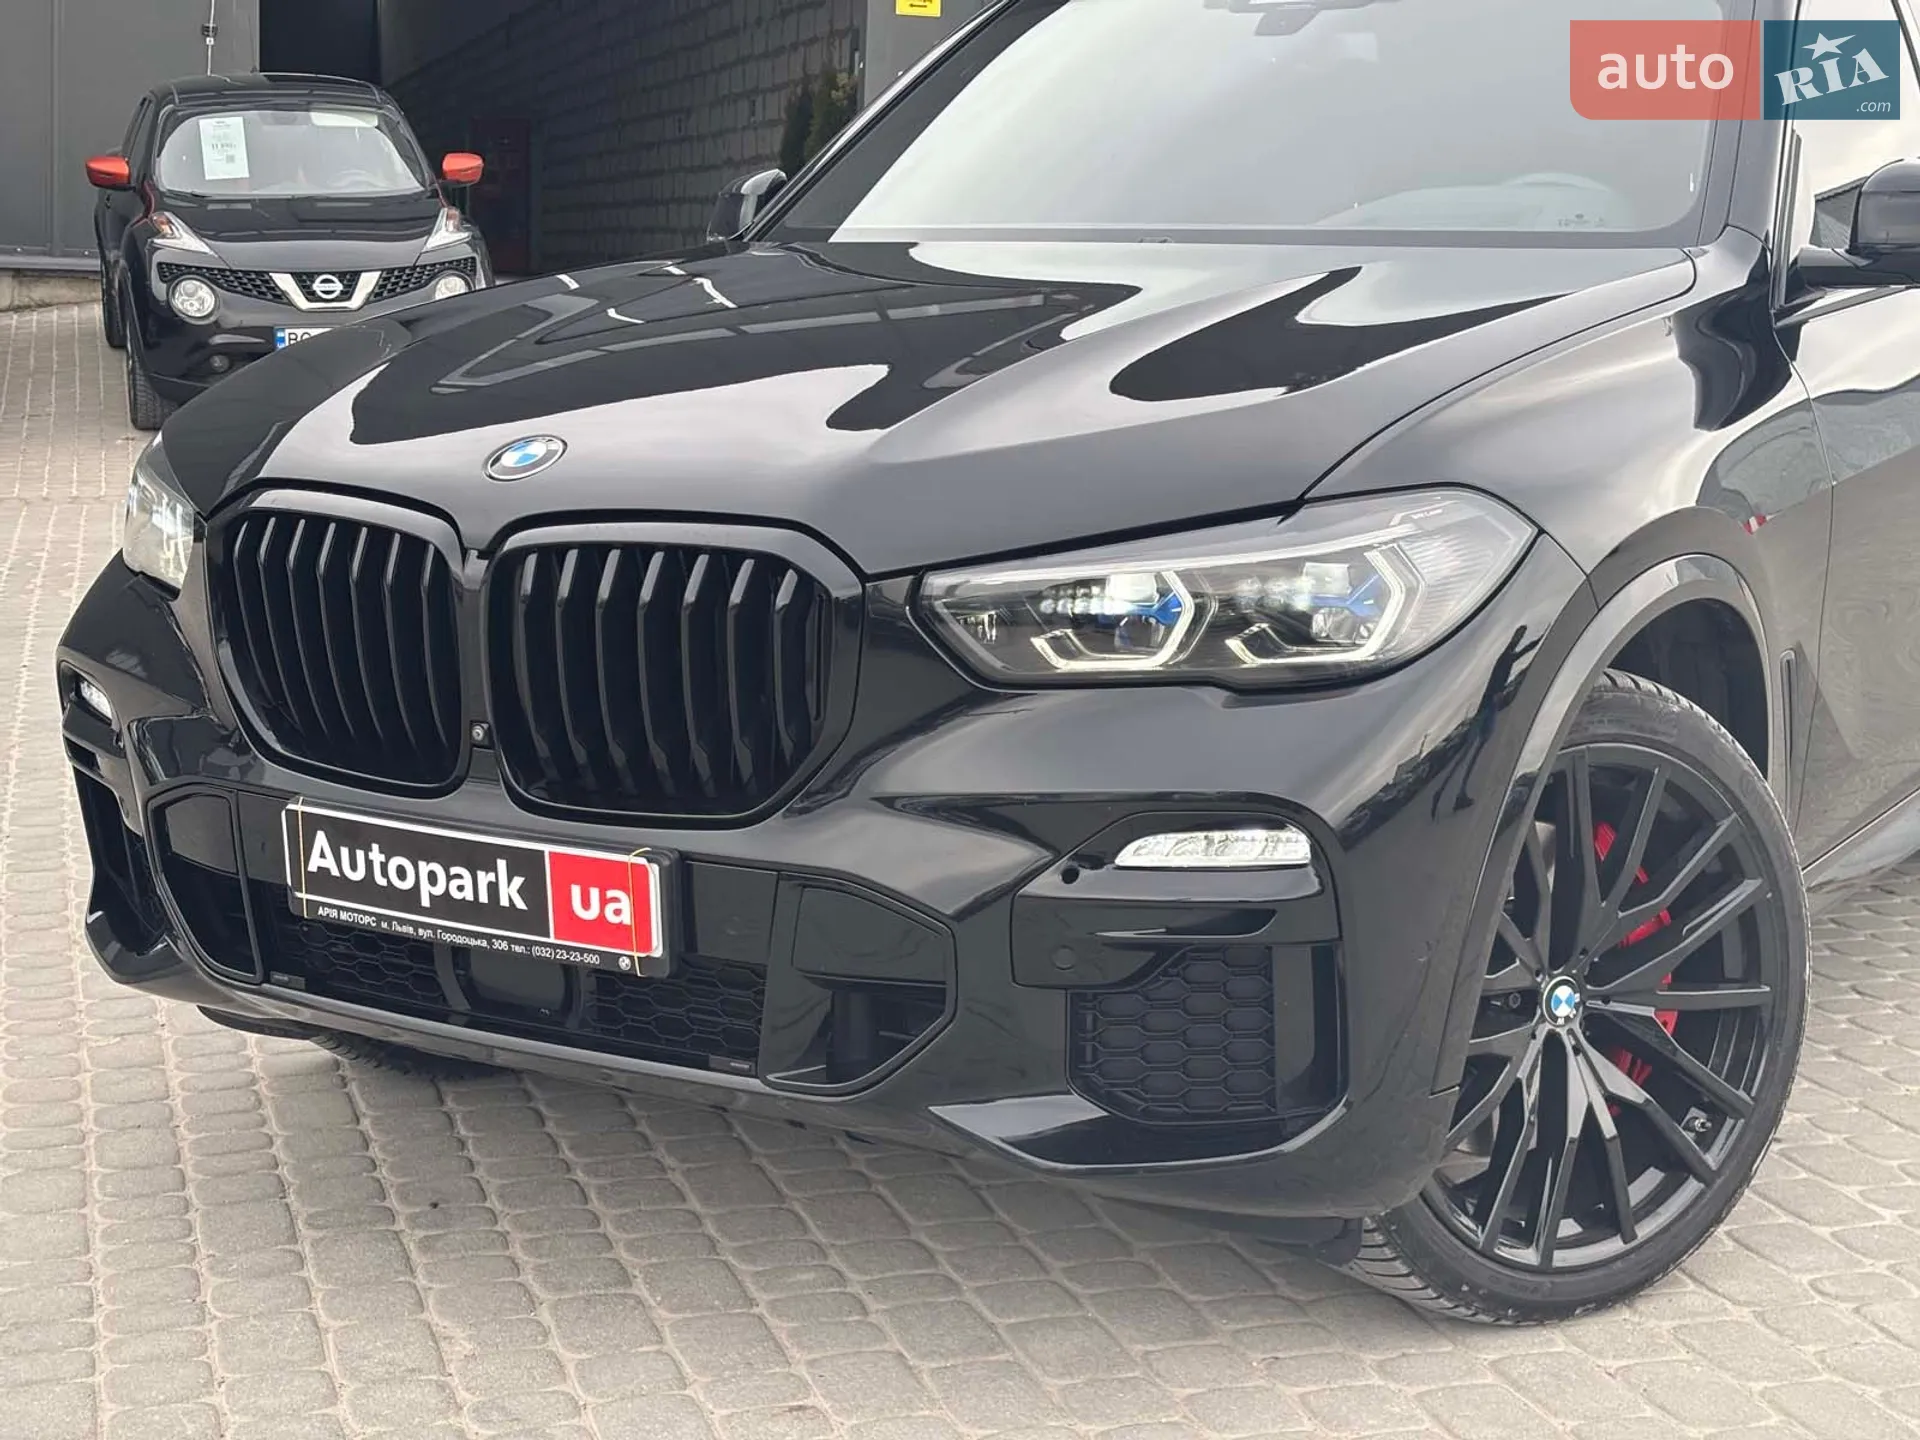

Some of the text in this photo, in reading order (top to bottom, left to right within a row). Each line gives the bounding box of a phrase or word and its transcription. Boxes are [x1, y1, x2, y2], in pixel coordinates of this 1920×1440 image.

[307, 830, 632, 926] Autopark ua
[317, 905, 600, 965] АРІЯ МОТОРС м. Львів, вул. Городоцька, 306 тел.: (032) 23-23-500
